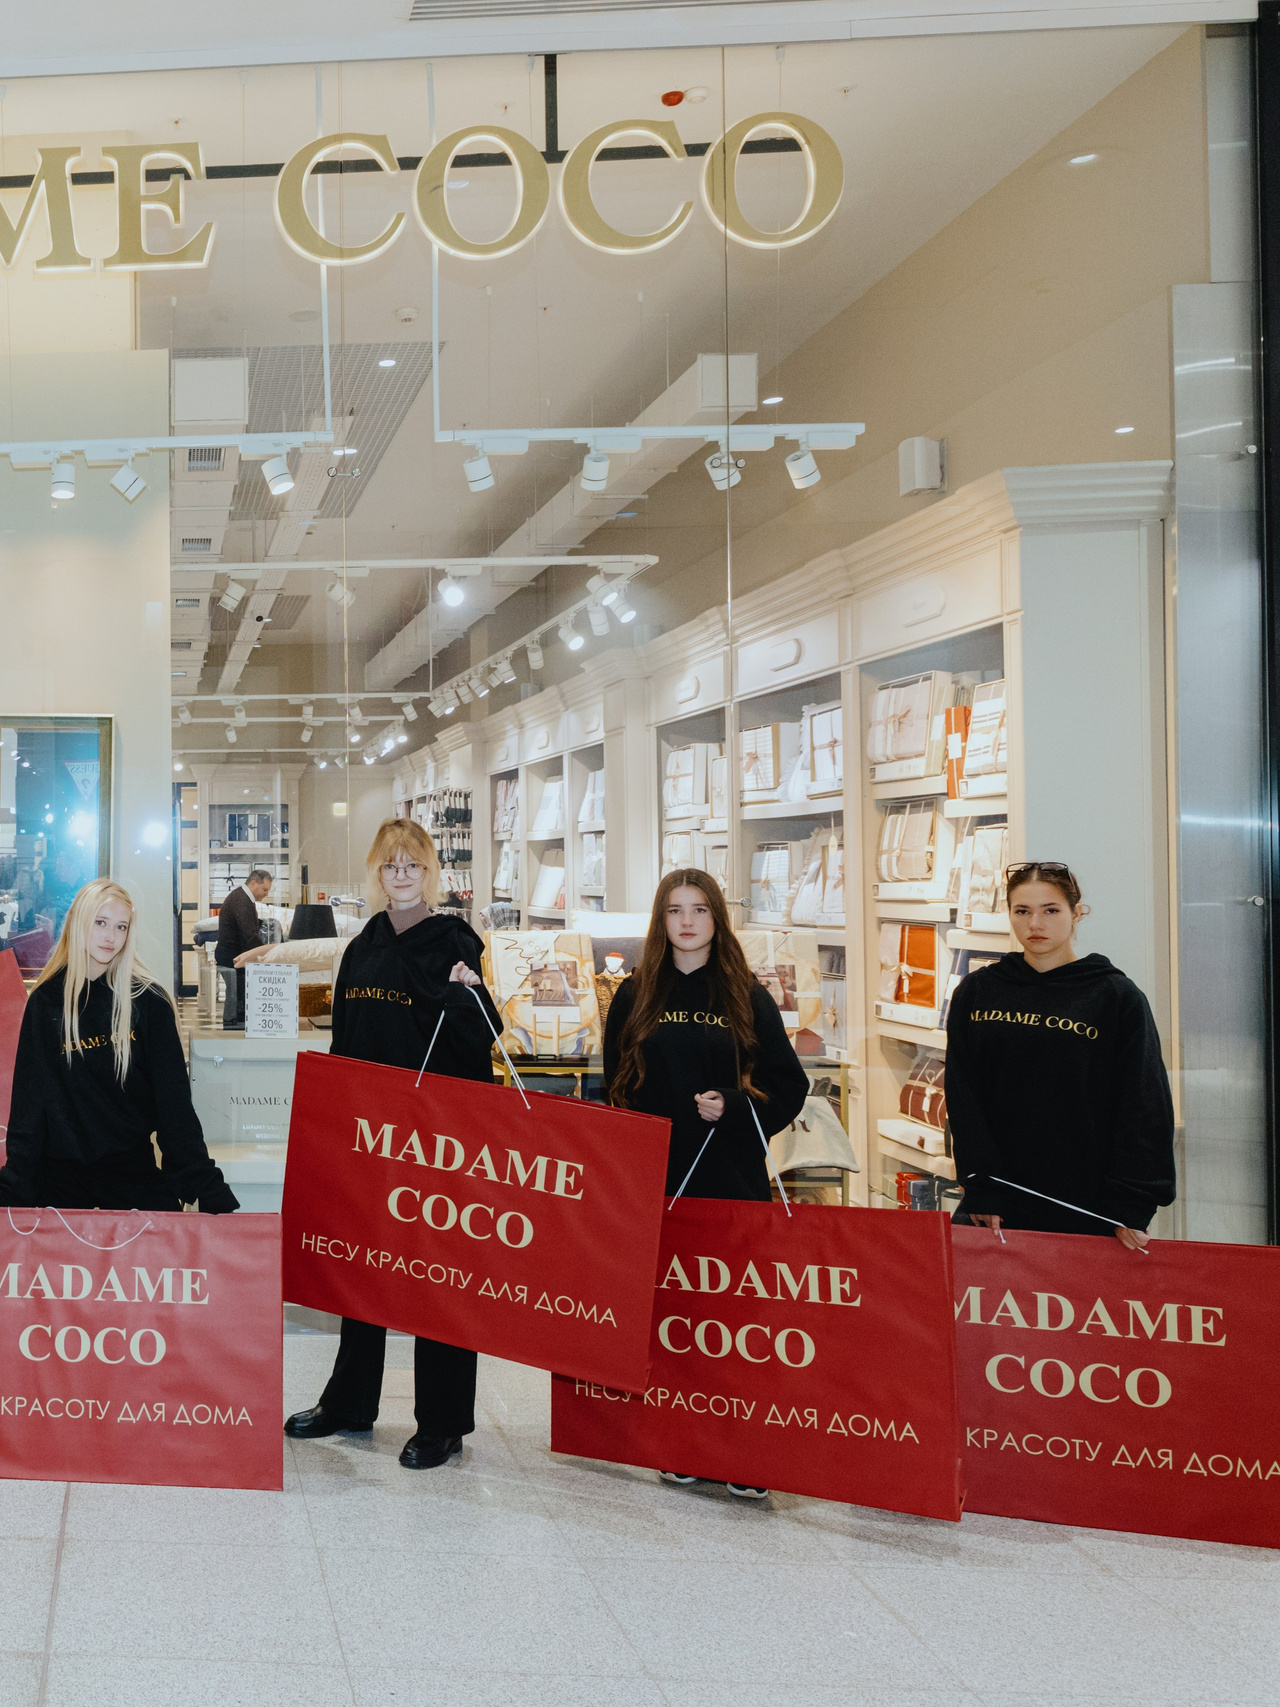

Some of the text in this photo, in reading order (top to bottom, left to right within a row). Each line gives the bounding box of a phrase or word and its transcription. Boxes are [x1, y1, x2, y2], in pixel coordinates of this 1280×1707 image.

[273, 110, 845, 266] COCO
[258, 976, 286, 985] СКИДКА
[258, 987, 284, 997] -20%
[258, 1003, 283, 1013] -25%
[258, 1019, 283, 1029] -30%
[693, 1011, 730, 1028] COC
[970, 1010, 1099, 1040] MADAME COCO
[229, 1096, 280, 1106] MADAME
[351, 1117, 584, 1200] MADAME
[387, 1186, 534, 1249] COCO
[301, 1232, 618, 1328] НЕСУ КРАСОТУ ДЛЯ ДОМА
[654, 1254, 862, 1307] ADAME
[658, 1315, 816, 1368] COCO
[953, 1285, 1227, 1347] MADAME
[18, 1324, 167, 1366] COCO
[985, 1353, 1172, 1408] COCO
[0, 1395, 111, 1420] КРАСОТУ
[117, 1401, 166, 1424] ДЛЯ
[172, 1403, 253, 1426] ДОМА
[643, 1386, 757, 1421] КРАСОТУ
[764, 1403, 818, 1430] ДЛЯ
[826, 1411, 920, 1444] ДОМА
[966, 1426, 1280, 1481] КРАСОТУ ДЛЯ ДОМА
